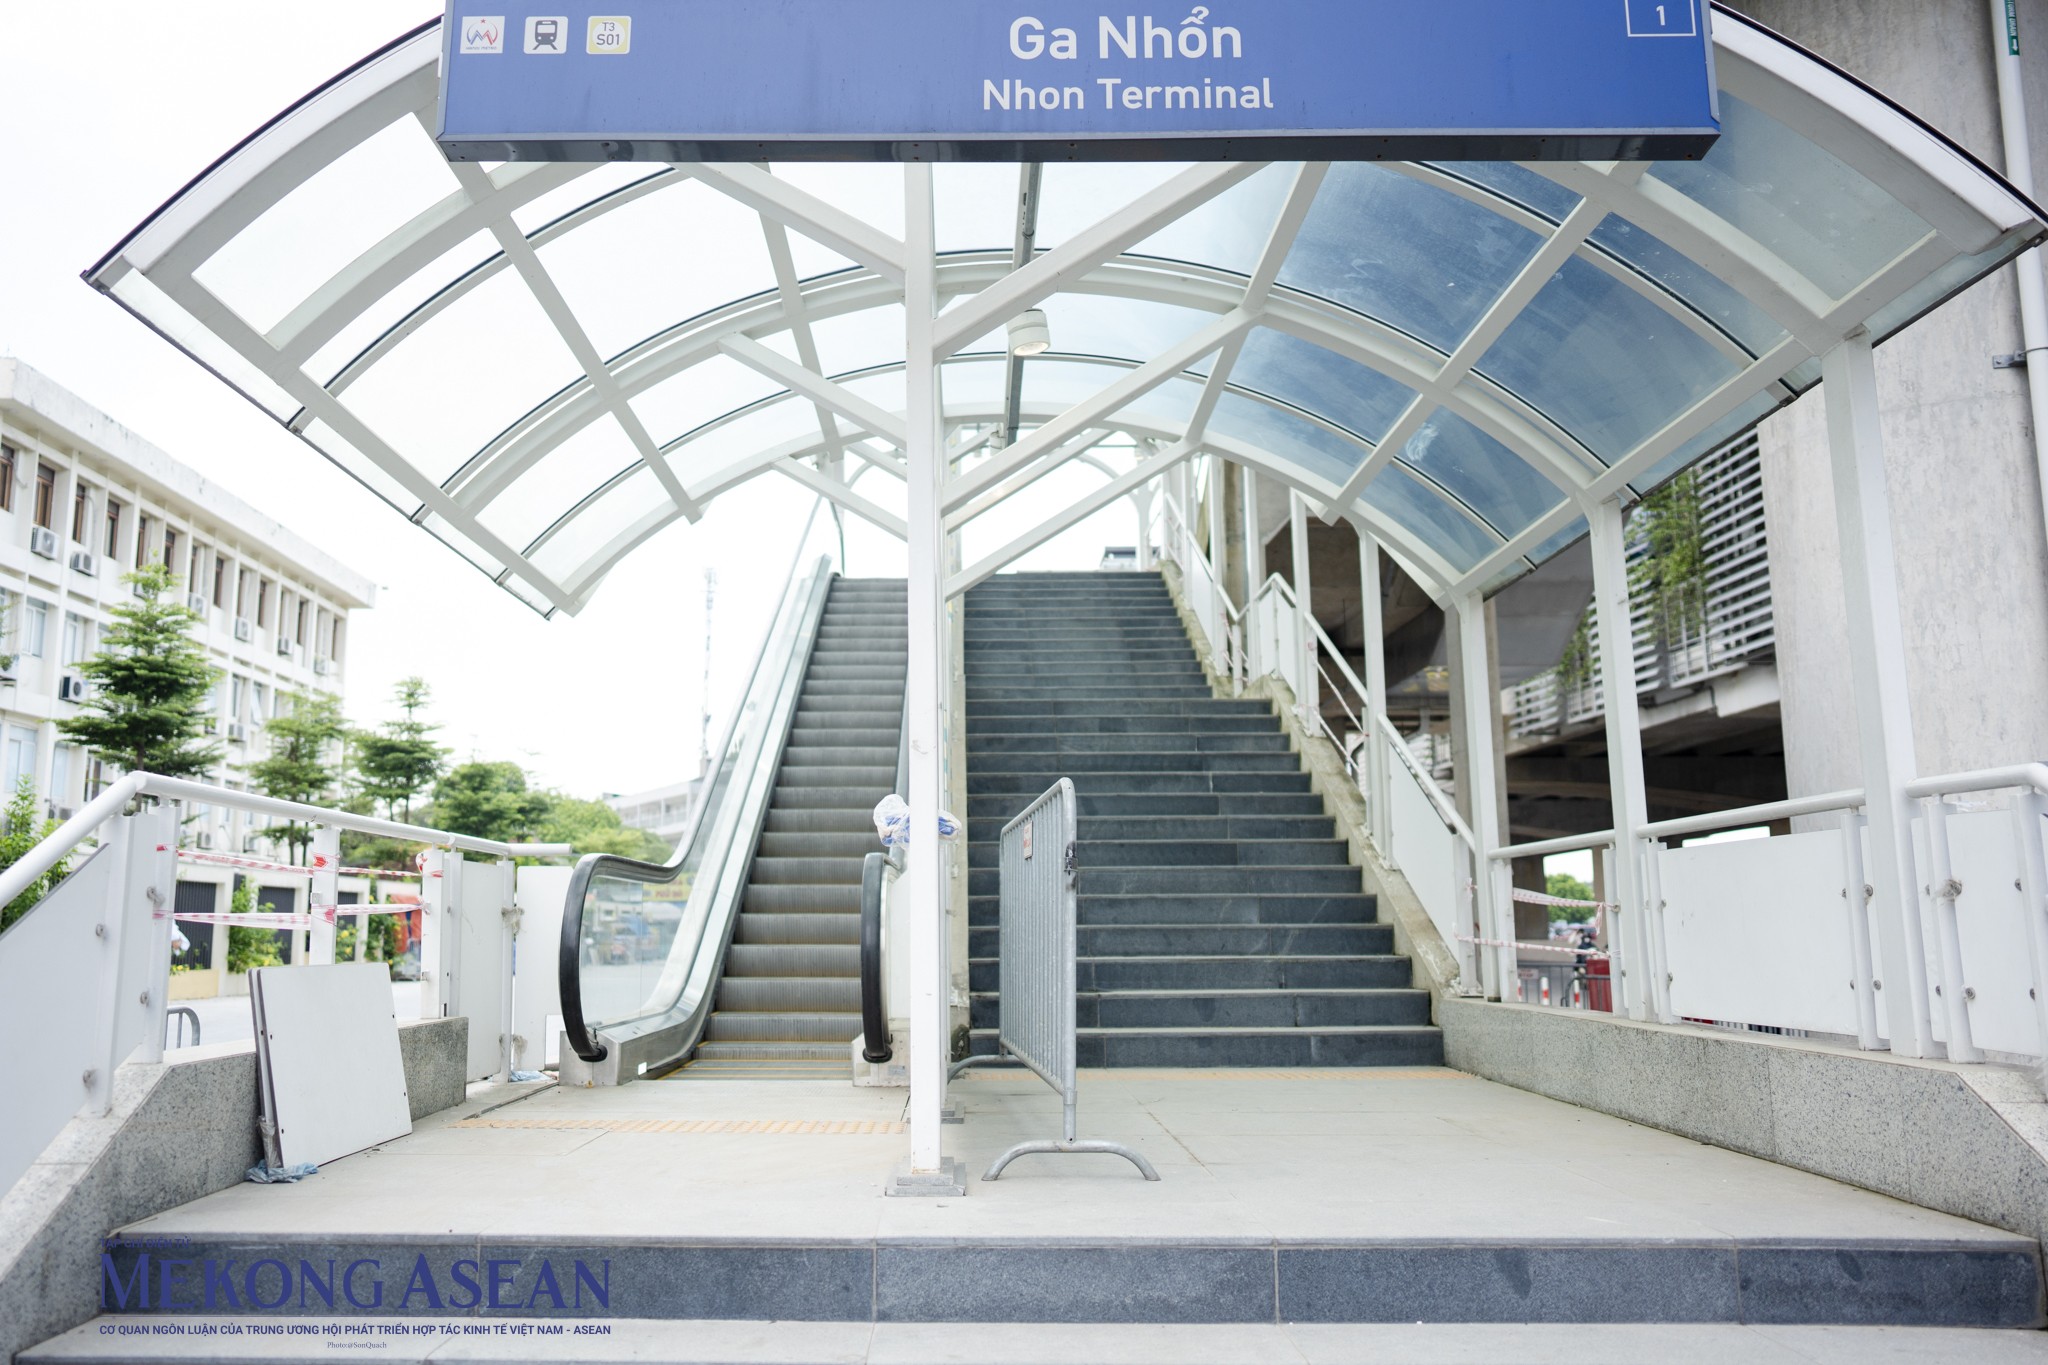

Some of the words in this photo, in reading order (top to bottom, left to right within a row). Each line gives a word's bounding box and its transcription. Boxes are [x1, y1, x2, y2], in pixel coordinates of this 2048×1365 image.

[1656, 5, 1665, 25] 1
[602, 22, 616, 32] T3
[1010, 16, 1077, 60] Ga
[1098, 6, 1242, 59] Nhổn
[596, 34, 621, 46] S01
[983, 79, 1084, 110] Nhon
[1097, 77, 1274, 109] Terminal
